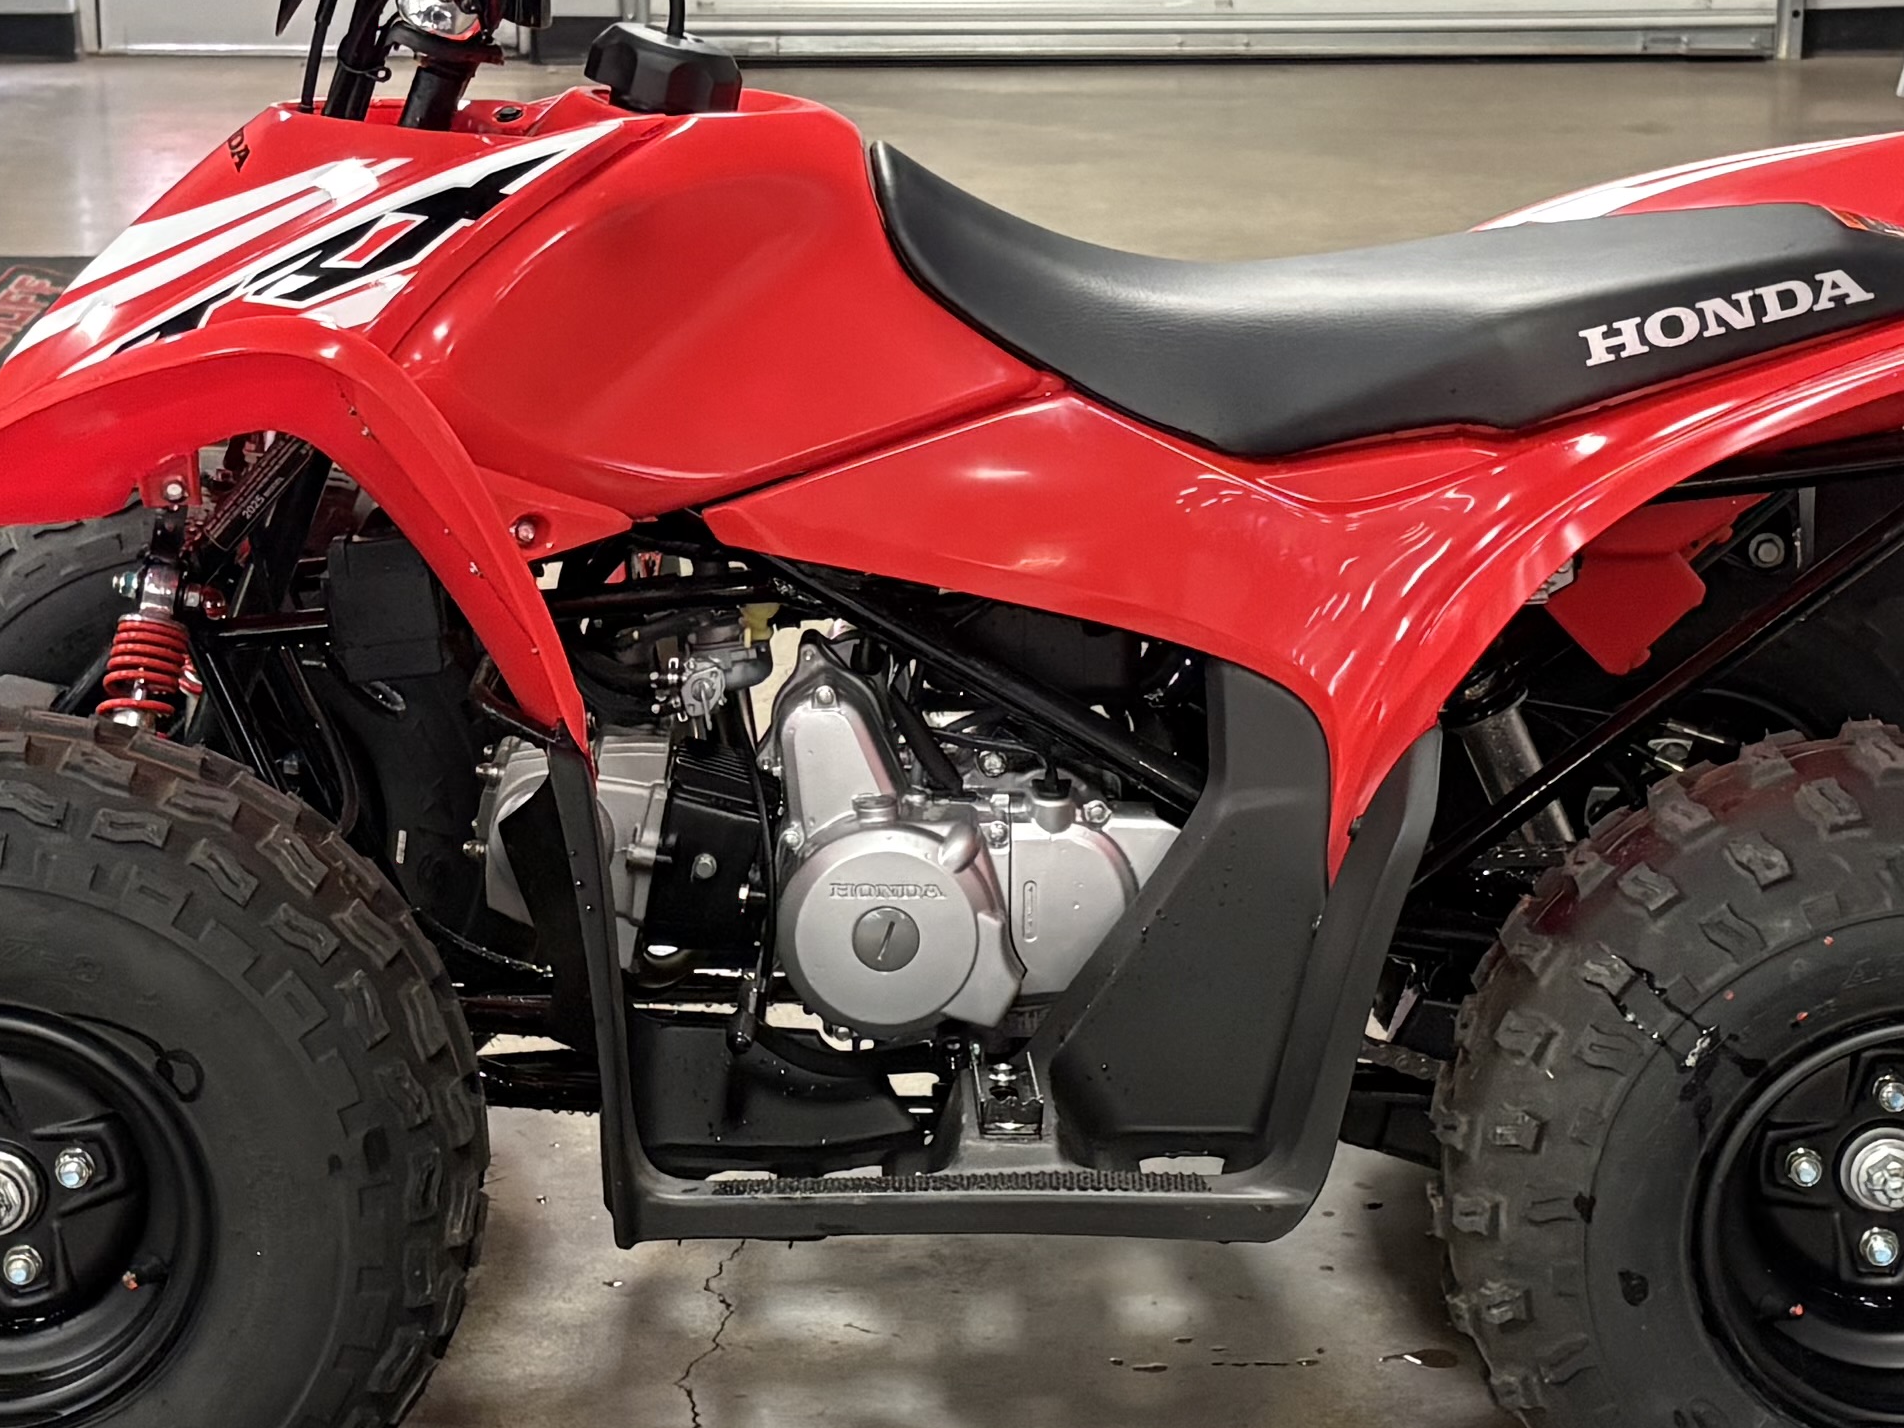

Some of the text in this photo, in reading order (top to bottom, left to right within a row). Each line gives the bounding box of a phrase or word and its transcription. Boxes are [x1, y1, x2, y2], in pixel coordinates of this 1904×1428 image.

[1578, 269, 1875, 367] HONDA
[241, 494, 266, 520] 2025
[829, 883, 947, 900] HONDA
